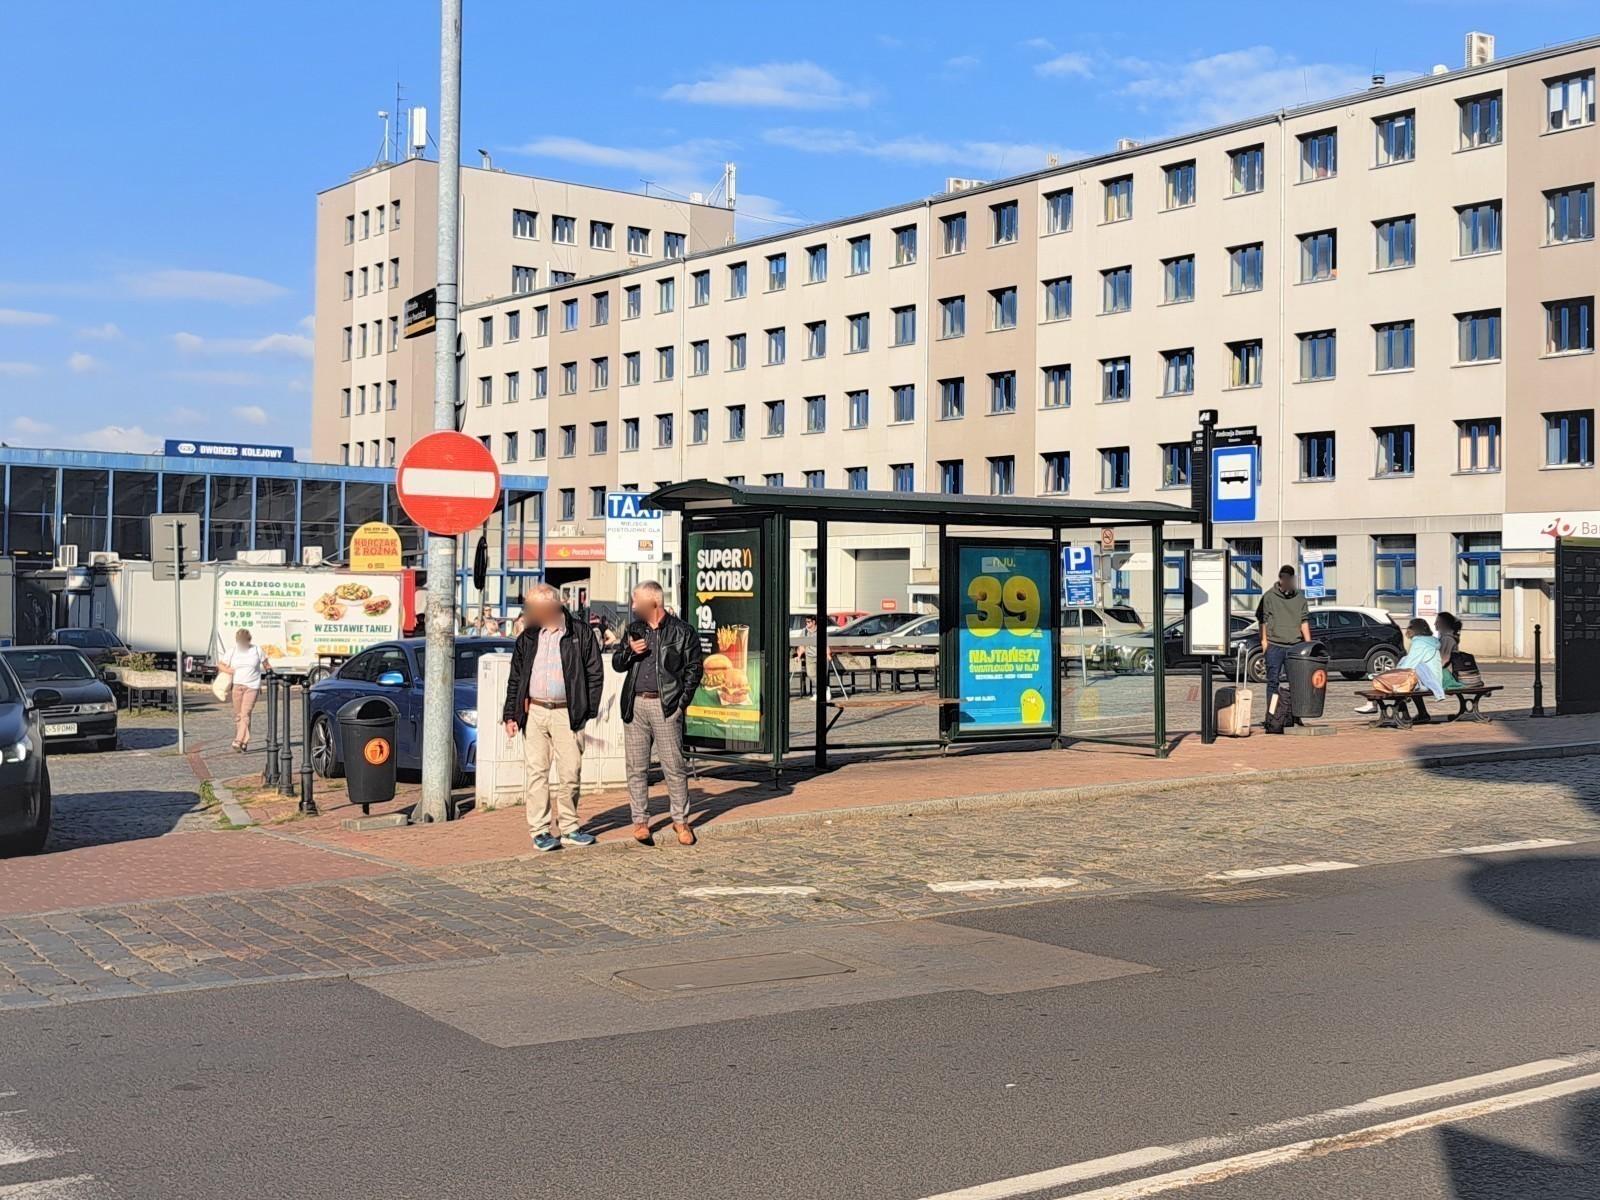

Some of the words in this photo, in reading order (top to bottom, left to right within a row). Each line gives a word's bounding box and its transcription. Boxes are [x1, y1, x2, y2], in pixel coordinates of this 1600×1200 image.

[200, 445, 238, 456] DWORZEC
[242, 447, 282, 458] KOLEJOWY
[1582, 522, 1600, 535] Ba
[1069, 547, 1086, 570] P
[1308, 563, 1320, 580] P
[239, 579, 281, 588] KAŻDEGO
[233, 599, 274, 607] ZIEMNIACZKI
[277, 599, 298, 608] NAPÓJ
[966, 575, 1040, 638] 39
[314, 624, 322, 632] W
[323, 624, 364, 632] ZESTAWIE
[365, 625, 393, 633] TANIEJ
[968, 646, 1041, 663] NAJTAŃSZY
